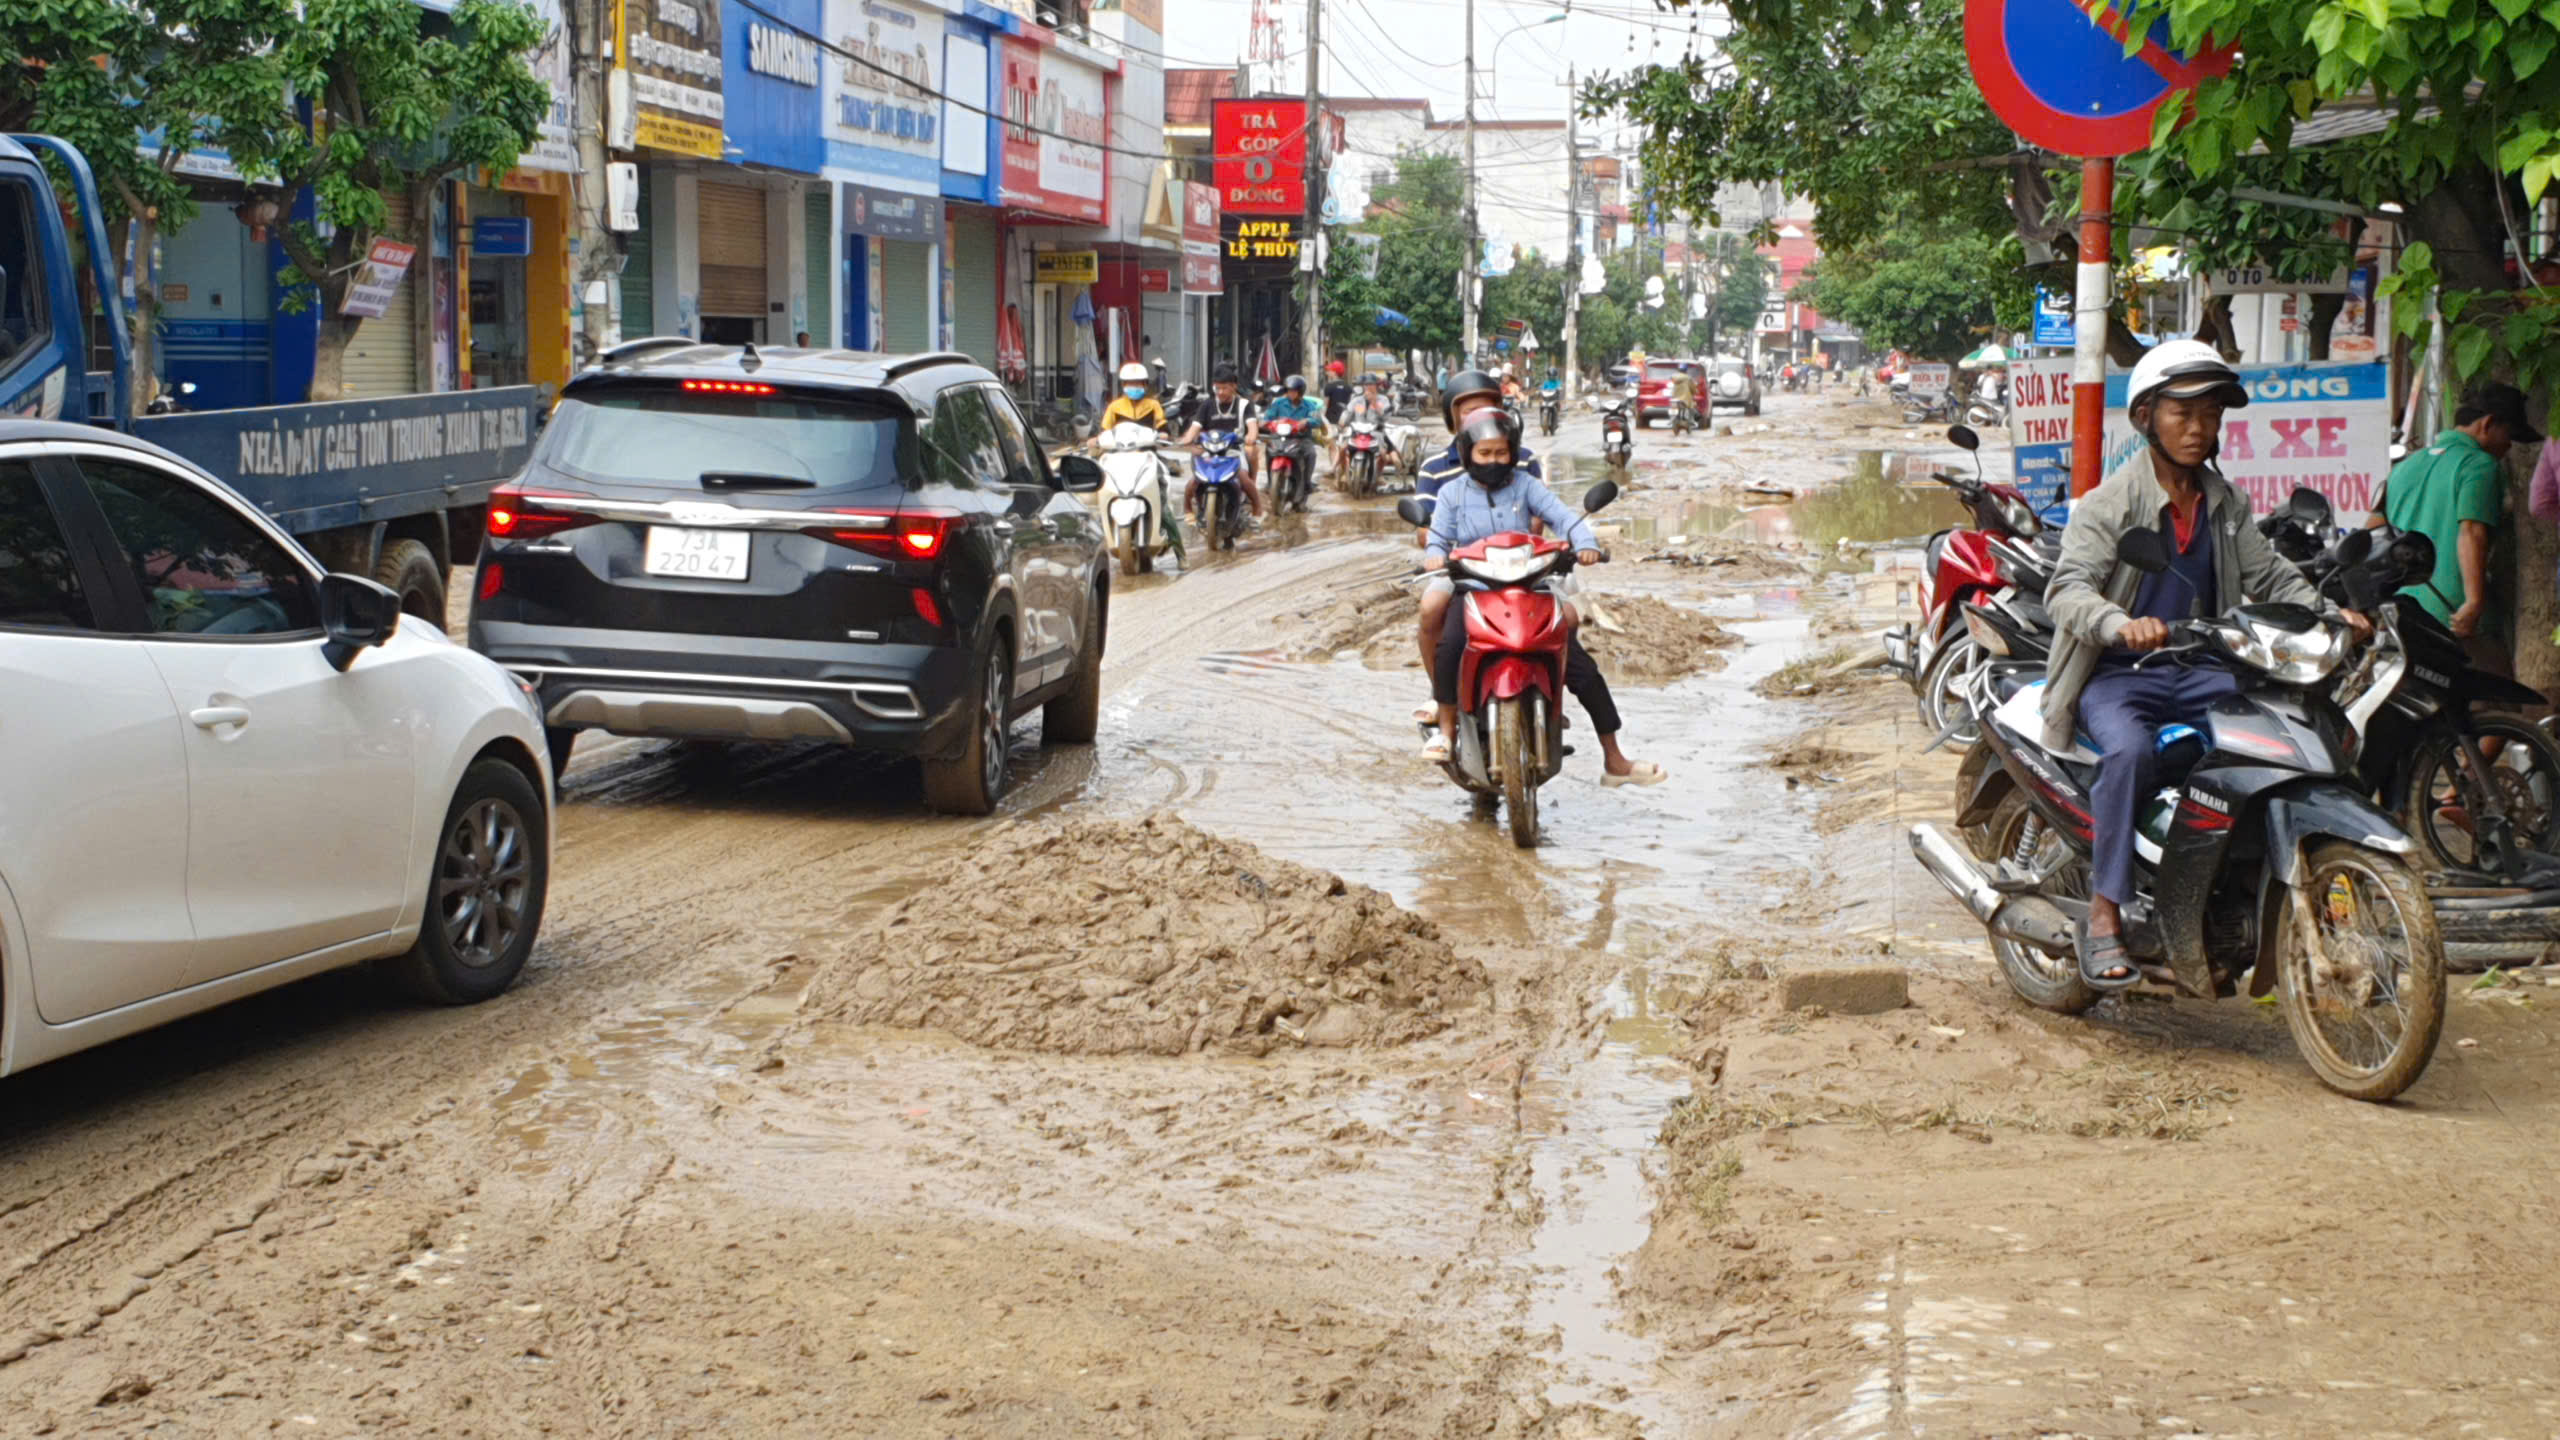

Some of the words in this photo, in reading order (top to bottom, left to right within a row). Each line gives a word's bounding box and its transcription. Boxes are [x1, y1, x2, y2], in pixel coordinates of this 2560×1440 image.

[751, 23, 818, 86] SAMSUNG
[1239, 222, 1290, 237] APPLE
[2050, 372, 2070, 406] XE
[239, 417, 284, 475] NHÀ
[2024, 417, 2068, 443] THAY
[2270, 417, 2347, 459] XE
[2189, 785, 2229, 814] YAMAHA
